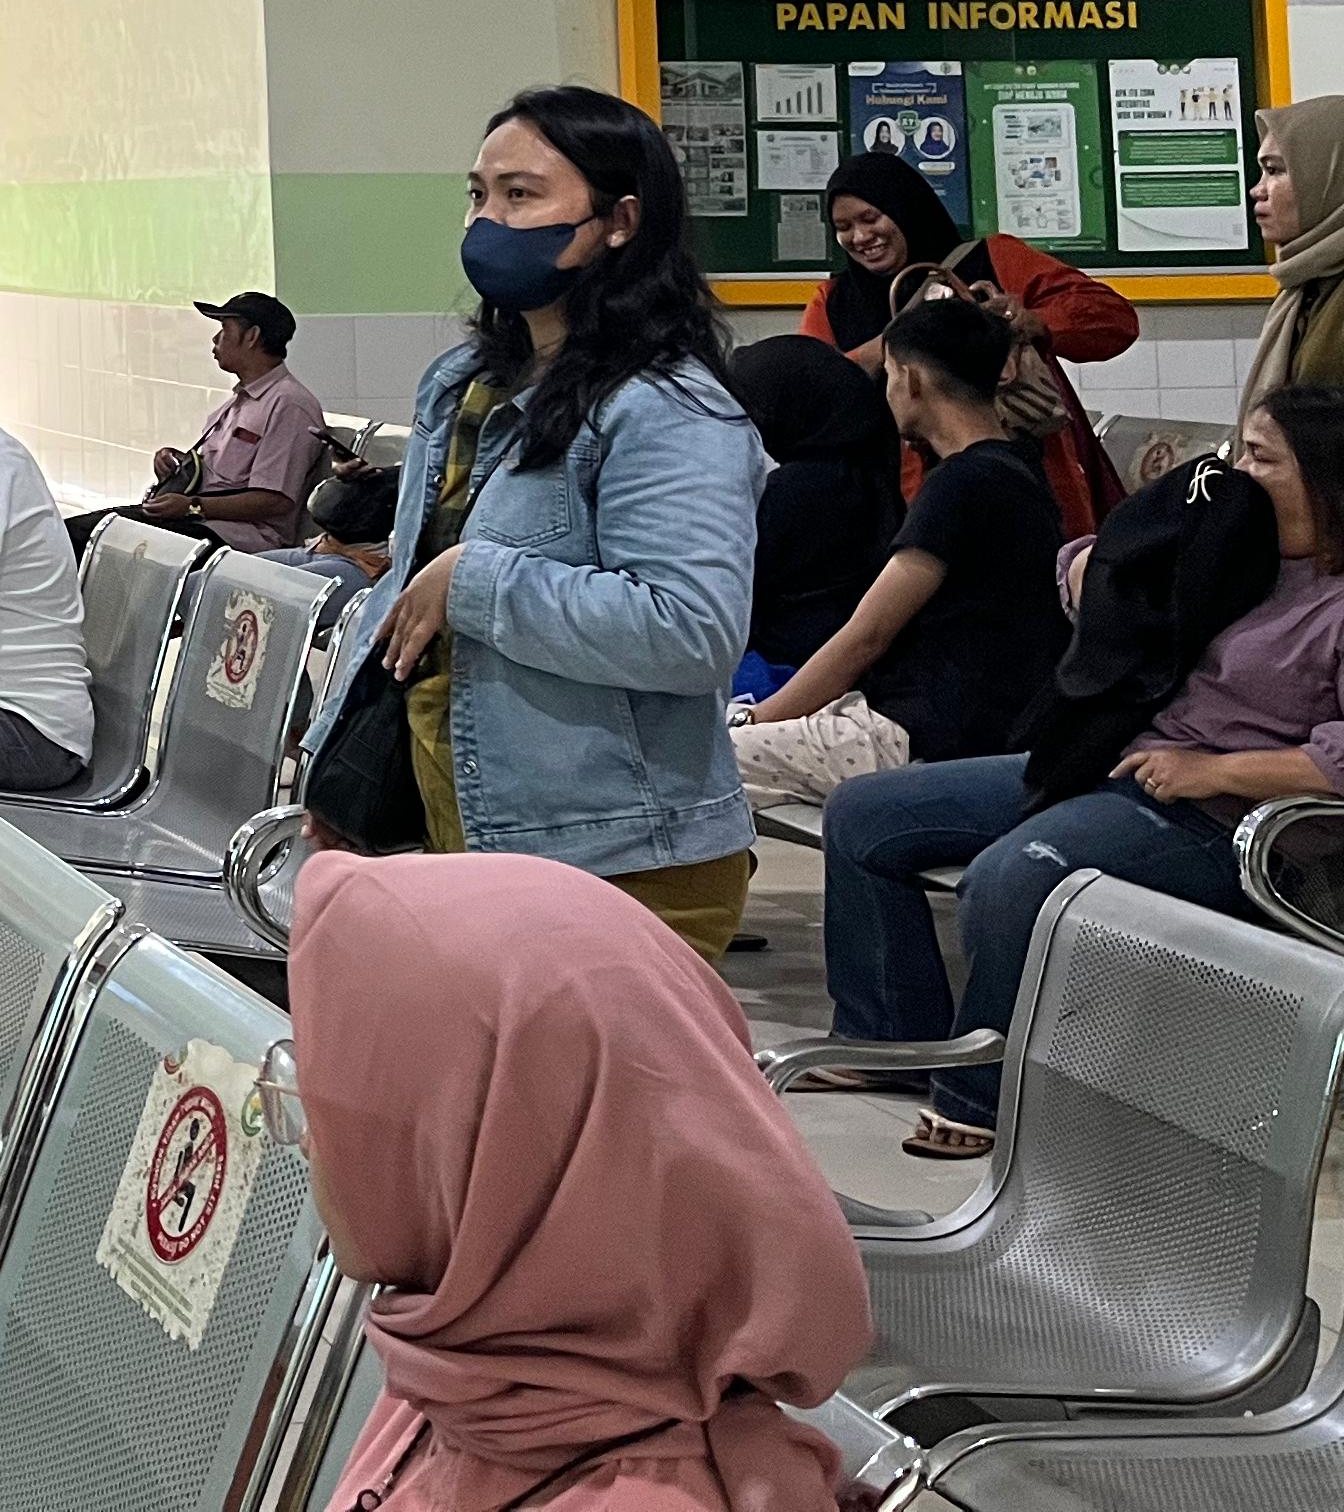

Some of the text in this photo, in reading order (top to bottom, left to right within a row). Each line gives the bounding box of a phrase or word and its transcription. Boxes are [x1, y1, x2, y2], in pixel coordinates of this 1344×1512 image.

[776, 0, 1139, 31] PAPAN INFORMASI
[191, 1216, 206, 1241] NOT
